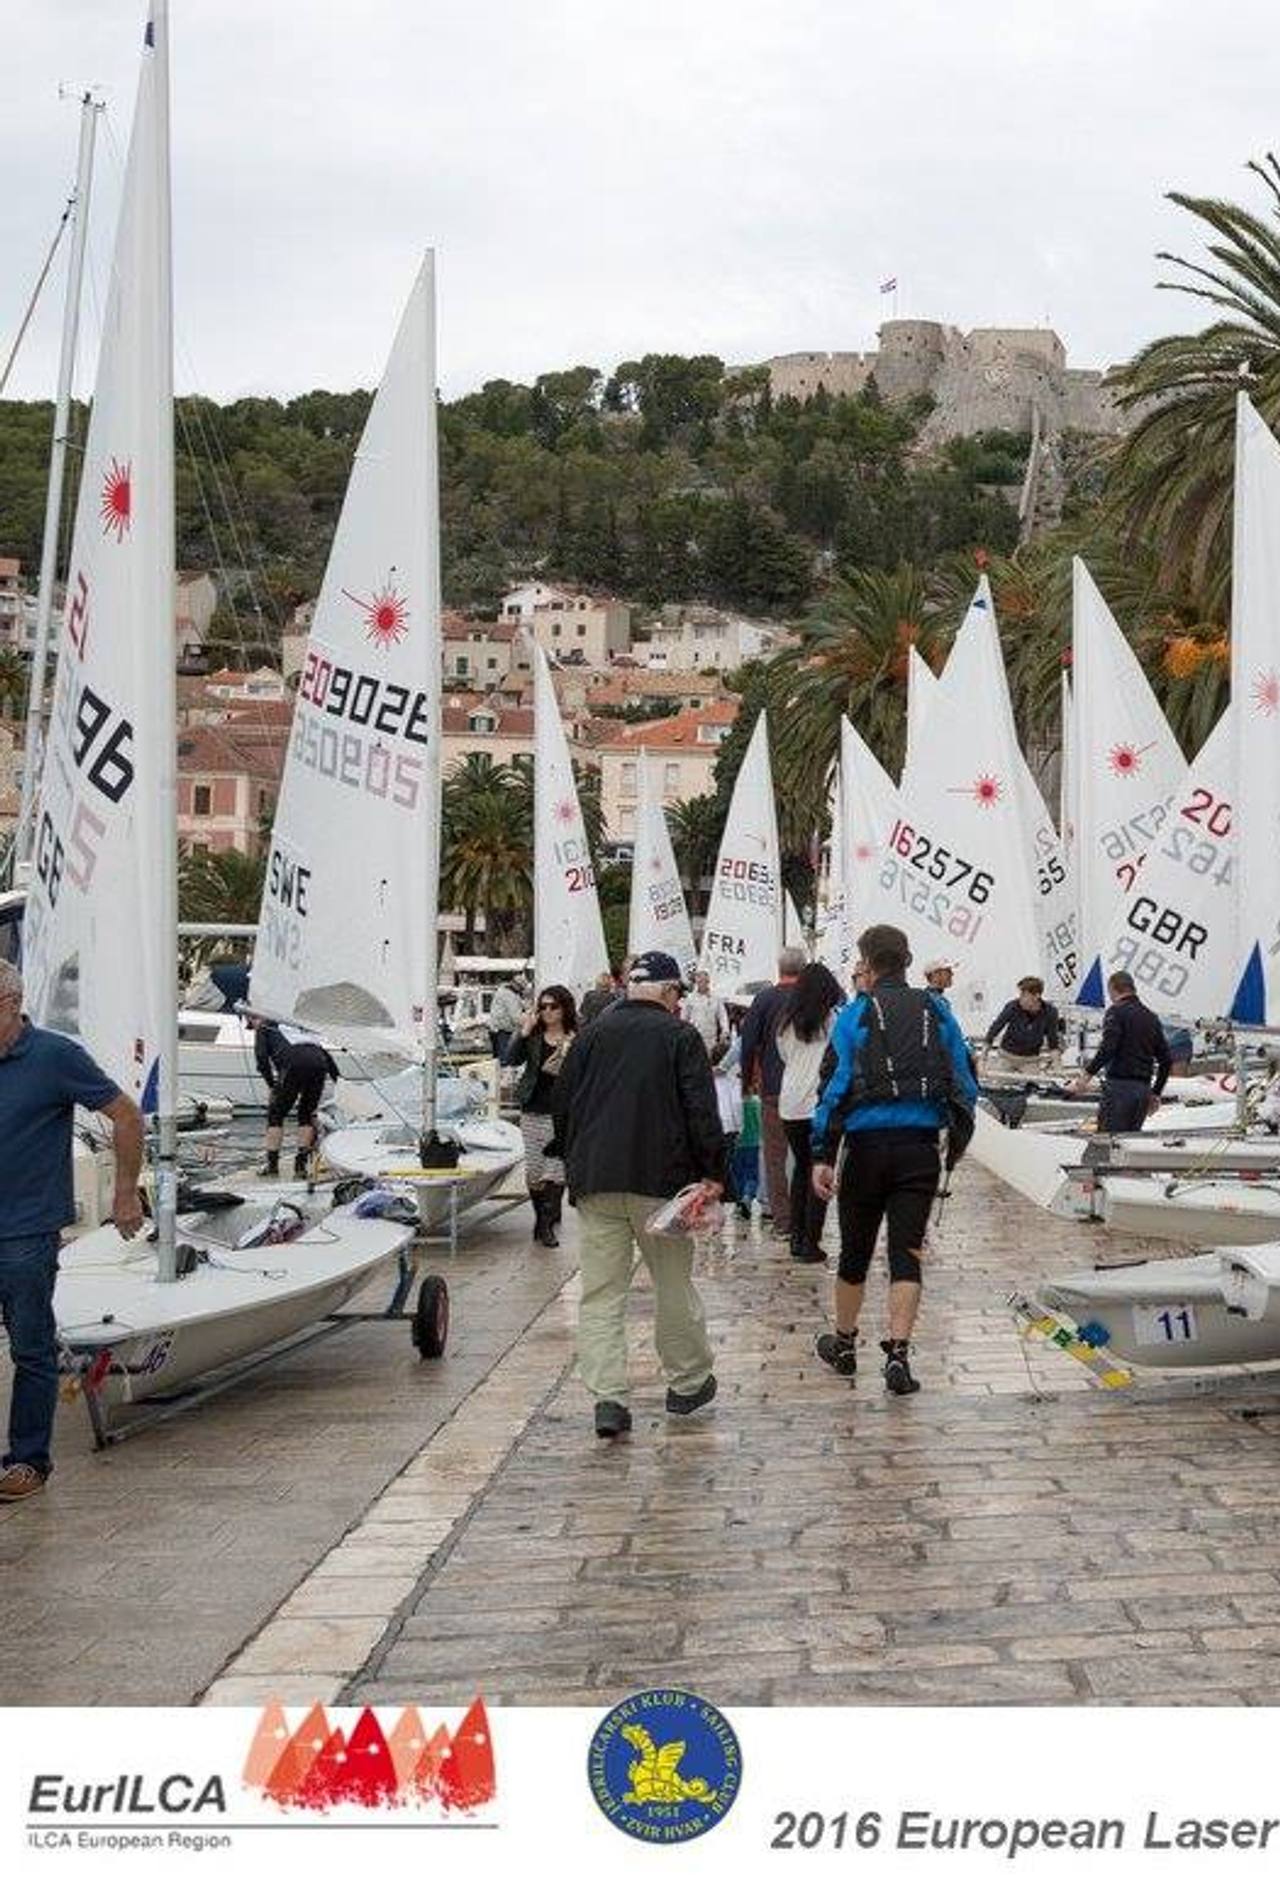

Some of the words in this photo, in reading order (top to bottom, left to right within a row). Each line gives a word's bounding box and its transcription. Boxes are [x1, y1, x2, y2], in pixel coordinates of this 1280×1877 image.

[270, 851, 311, 917] SWE
[889, 819, 994, 904] 162576
[708, 932, 746, 956] FRA
[1127, 897, 1208, 959] GBR
[1158, 1311, 1192, 1340] 11
